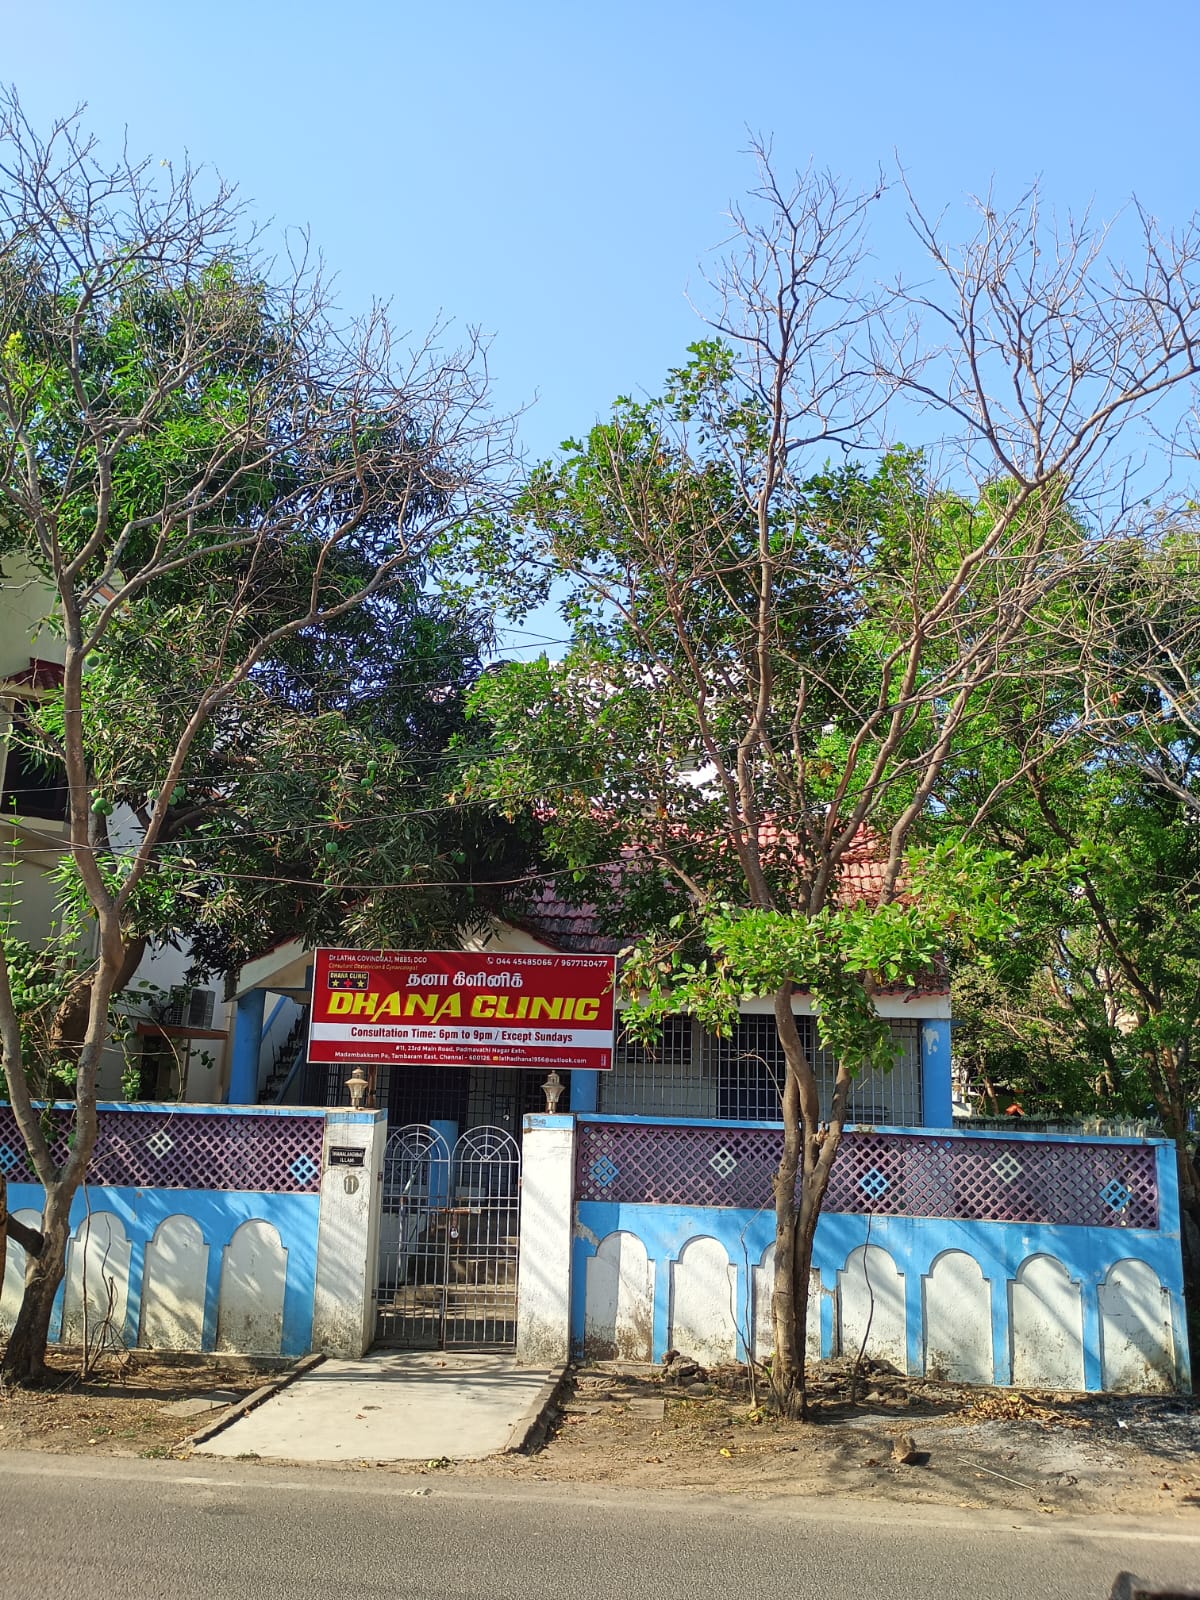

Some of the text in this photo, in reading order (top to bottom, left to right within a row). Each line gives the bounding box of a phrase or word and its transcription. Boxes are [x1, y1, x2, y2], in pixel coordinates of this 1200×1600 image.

[496, 957, 511, 965] 044
[554, 958, 560, 967] /
[561, 959, 608, 967] 9677120477
[405, 971, 524, 988] தனா கிளினிக்
[327, 990, 601, 1024] DHANA CLINIC
[351, 1026, 573, 1044] Consultation Time: 6pm to 9pm / Except Sundays
[346, 1178, 354, 1192] 11
